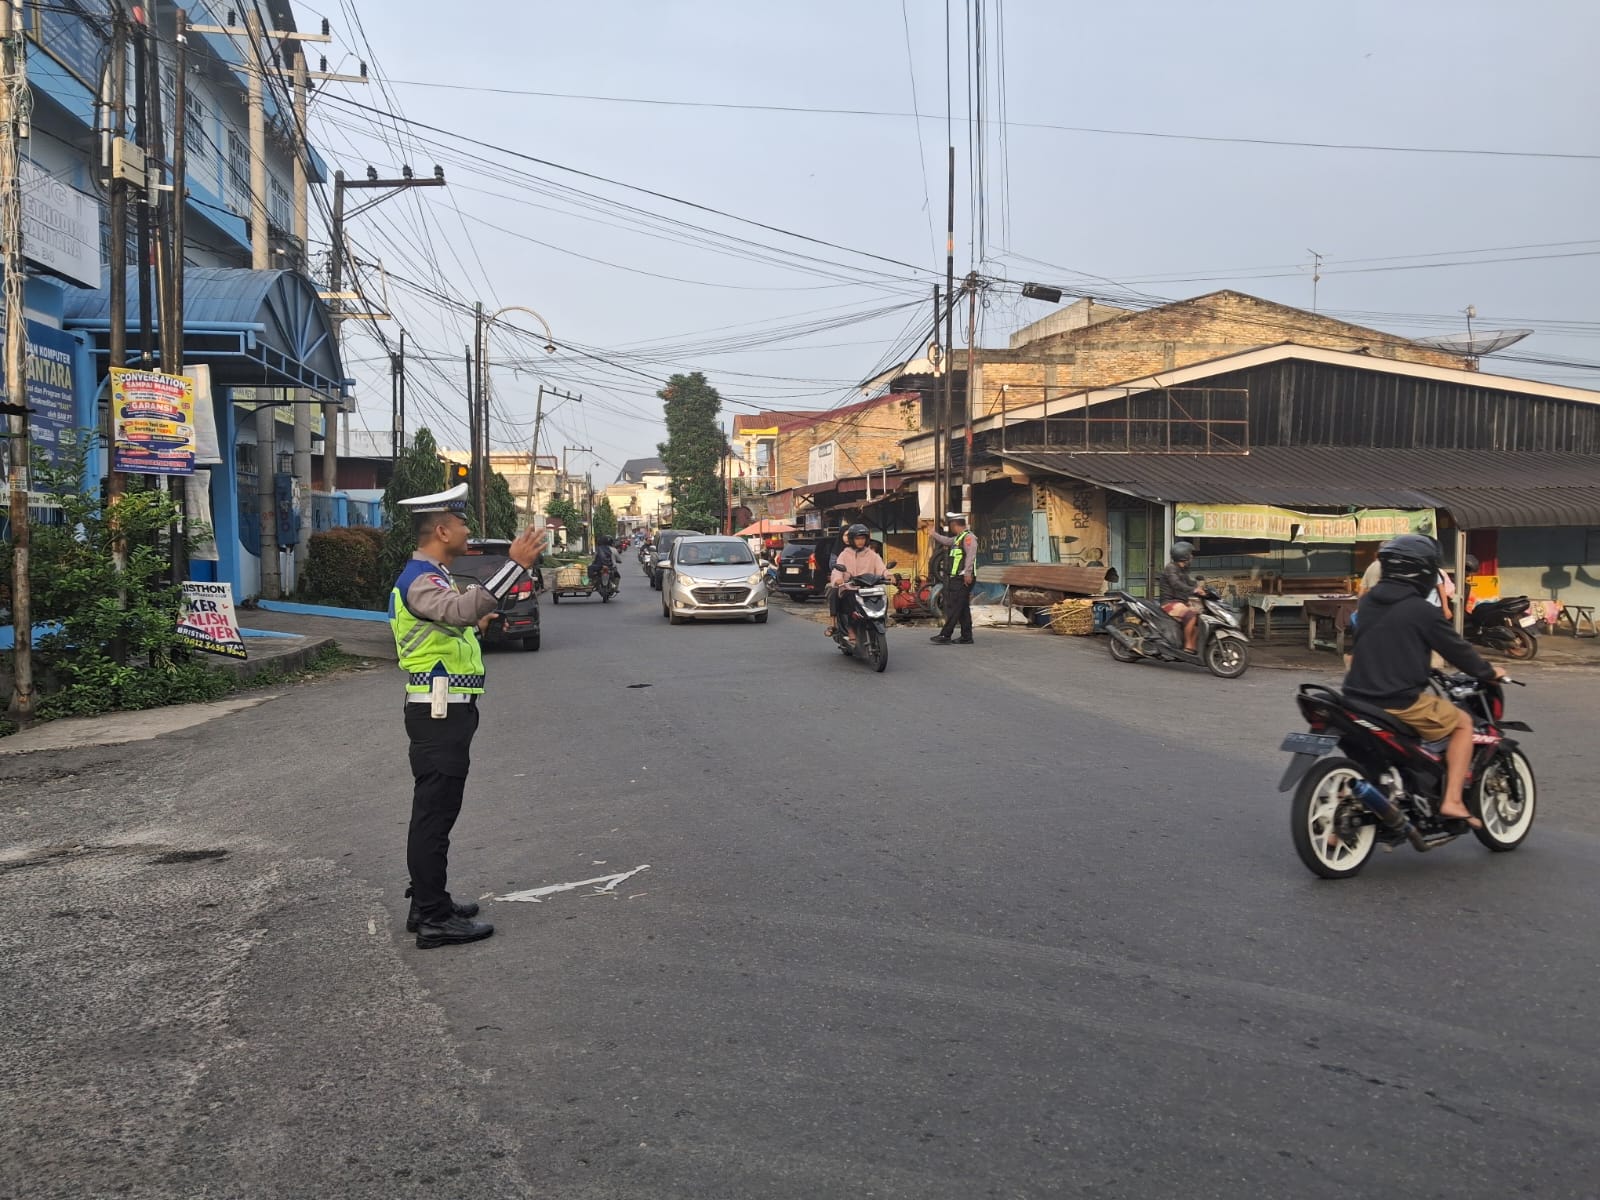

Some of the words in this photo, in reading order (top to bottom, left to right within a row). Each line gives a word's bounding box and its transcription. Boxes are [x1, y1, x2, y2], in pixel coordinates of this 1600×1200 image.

[39, 345, 71, 365] KOMPUTER
[26, 357, 73, 390] ANTARA
[119, 372, 186, 389] CONVERSATION
[132, 401, 173, 413] GARANSI
[1205, 511, 1218, 529] ES
[1222, 512, 1265, 531] KELAPA
[1315, 519, 1355, 537] KELAPA
[1360, 517, 1394, 535] BAKAR
[187, 599, 218, 613] KER
[187, 612, 229, 627] GLISH
[177, 626, 211, 641] BRISTHO
[204, 626, 235, 640] HER
